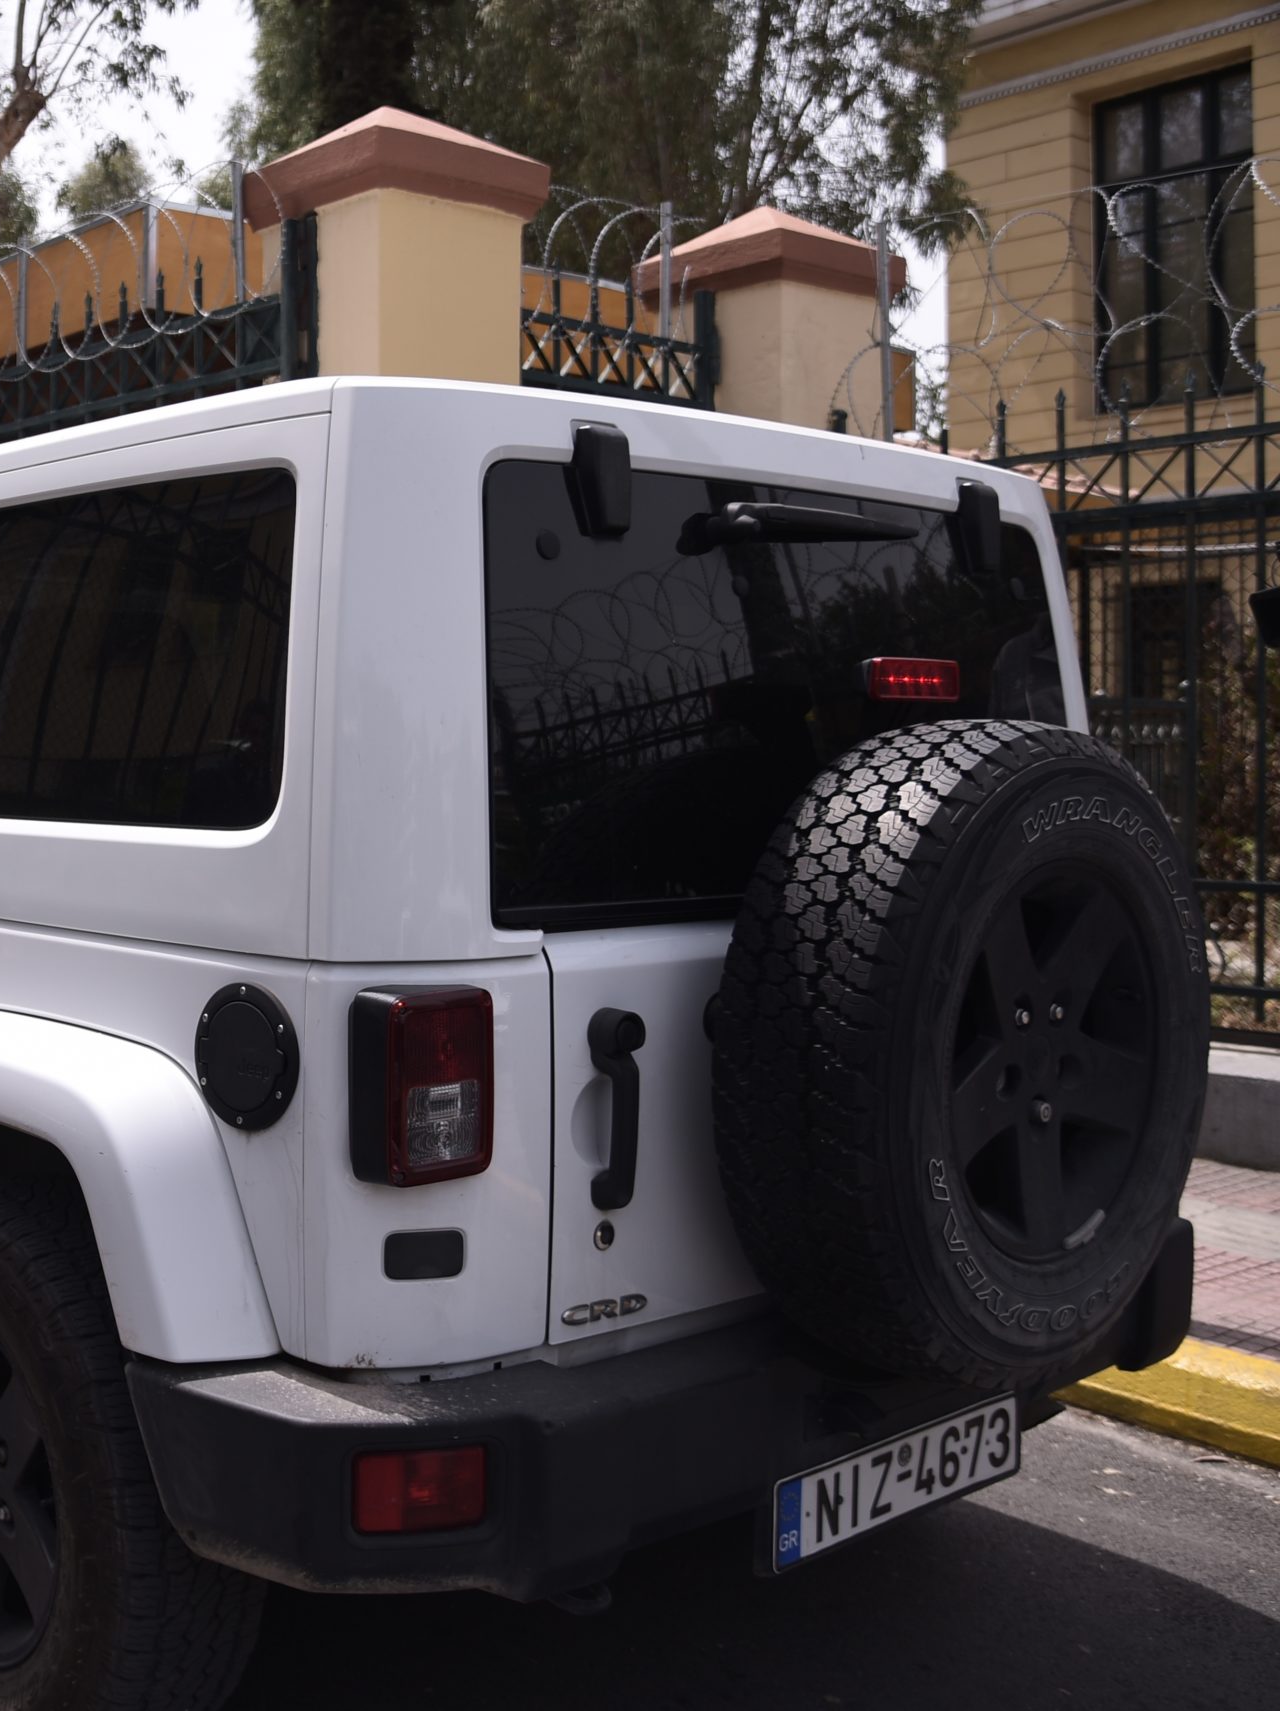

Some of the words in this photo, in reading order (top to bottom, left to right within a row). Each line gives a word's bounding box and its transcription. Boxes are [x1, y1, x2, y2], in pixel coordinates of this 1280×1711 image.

[1022, 796, 1203, 974] WRANGLER
[561, 1293, 648, 1326] CRD
[929, 1158, 1129, 1332] GOODYEAR
[779, 1530, 799, 1552] GR
[816, 1407, 1011, 1543] NIZ-4673
